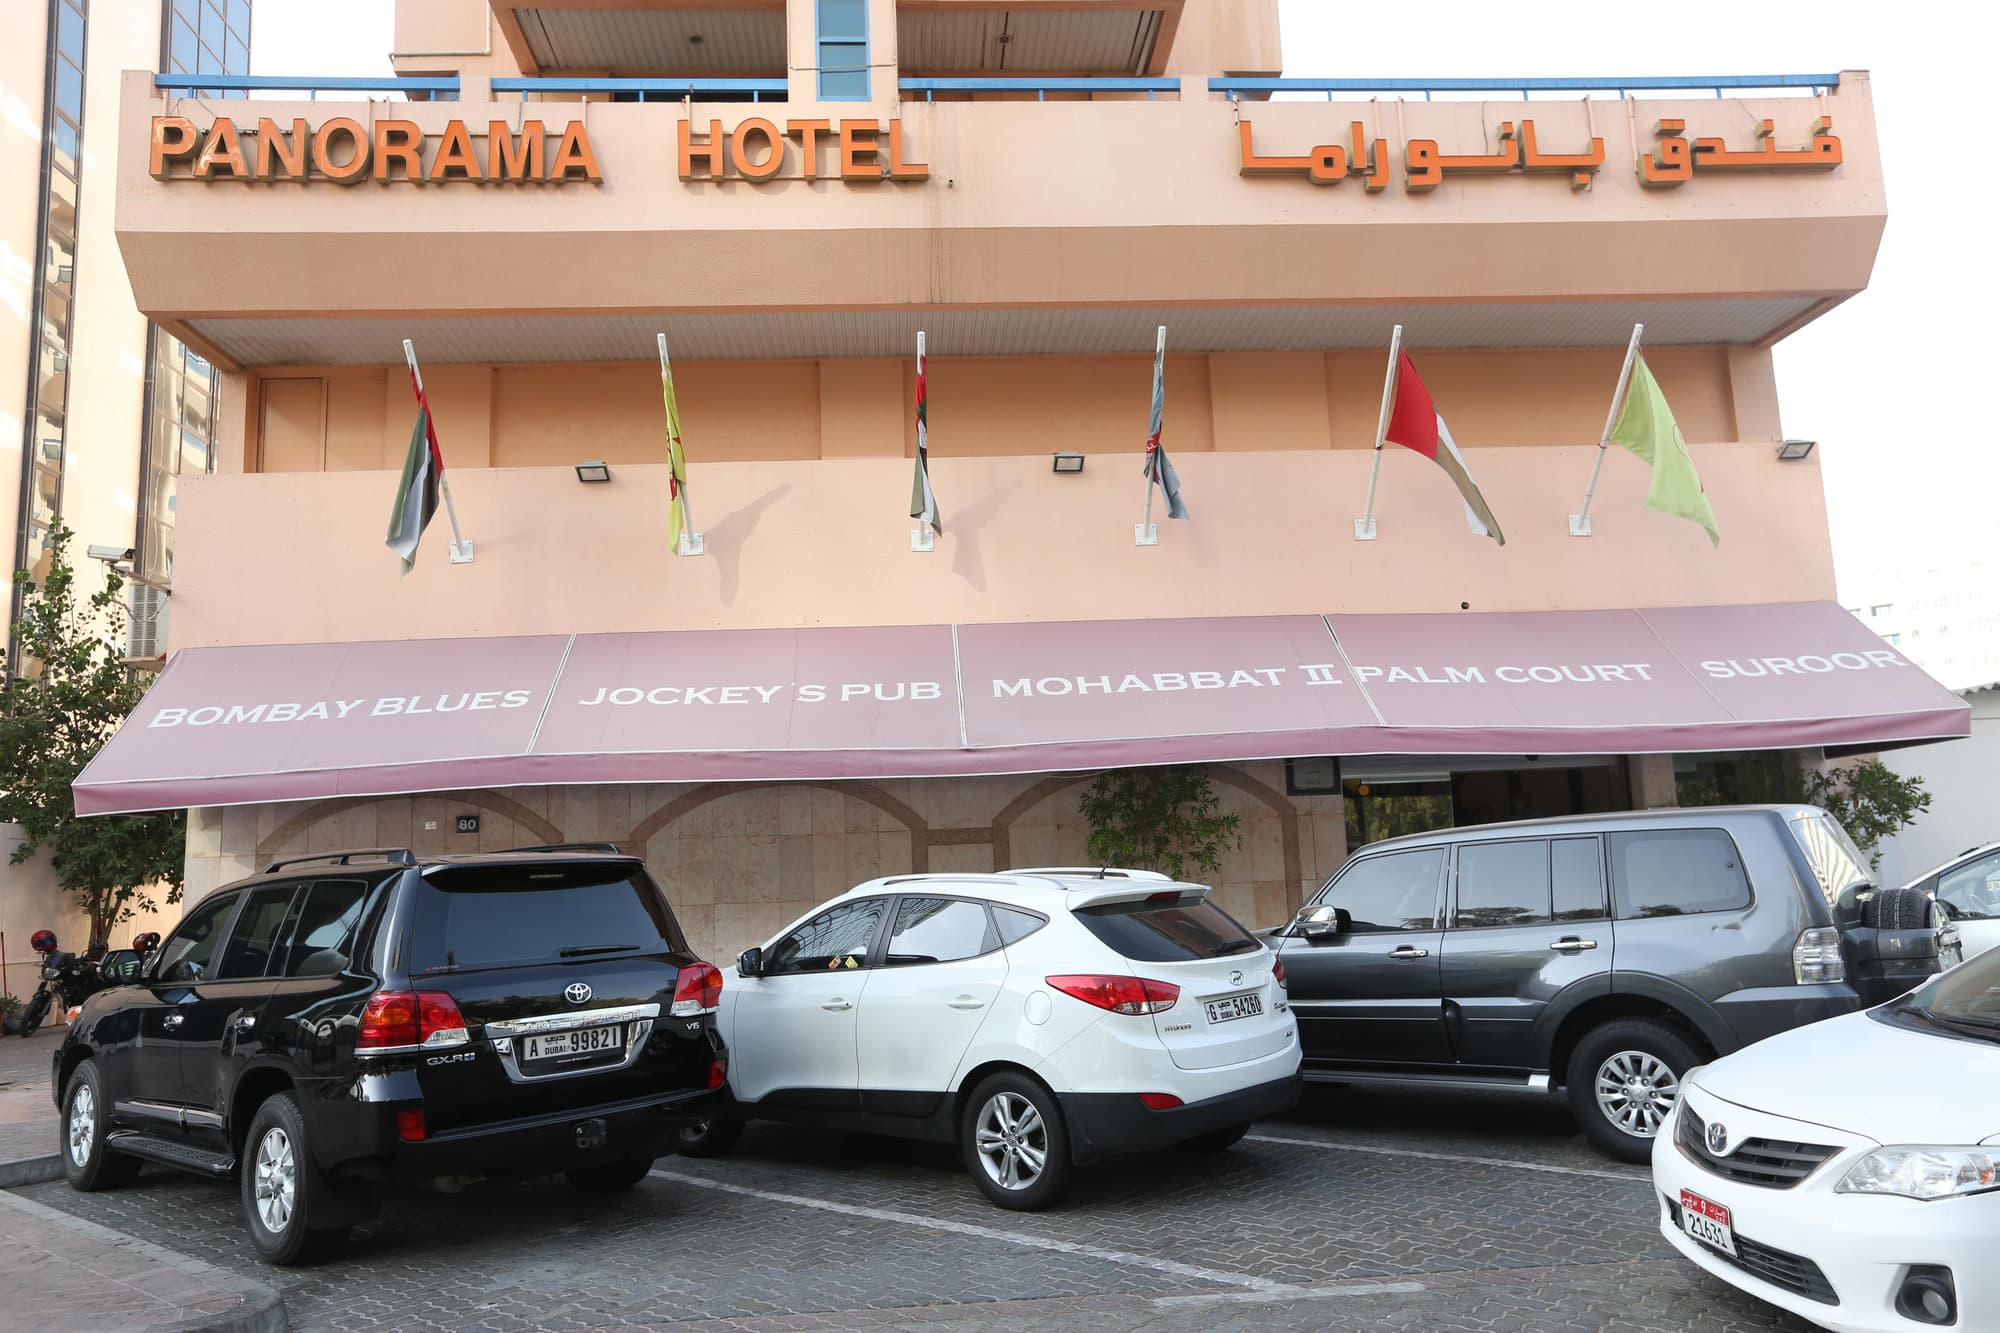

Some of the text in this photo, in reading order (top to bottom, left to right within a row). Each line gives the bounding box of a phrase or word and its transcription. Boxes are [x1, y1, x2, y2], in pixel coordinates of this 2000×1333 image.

[151, 116, 929, 184] PANORAMA HOTEL
[1238, 115, 1843, 193] فندق بانوراما
[1353, 663, 1654, 684] PALM COURT
[1699, 649, 1909, 680] SUROOR
[841, 681, 943, 702] PUB
[991, 663, 1343, 698] MOHABBAT II
[147, 690, 532, 729] BOMBAY BLUES
[458, 818, 477, 831] 80
[1208, 1004, 1217, 1020] G
[1233, 995, 1262, 1017] 54260
[529, 1027, 618, 1058] A 99821
[544, 1045, 567, 1056] DUBAI
[1688, 1212, 1729, 1250] 21631
